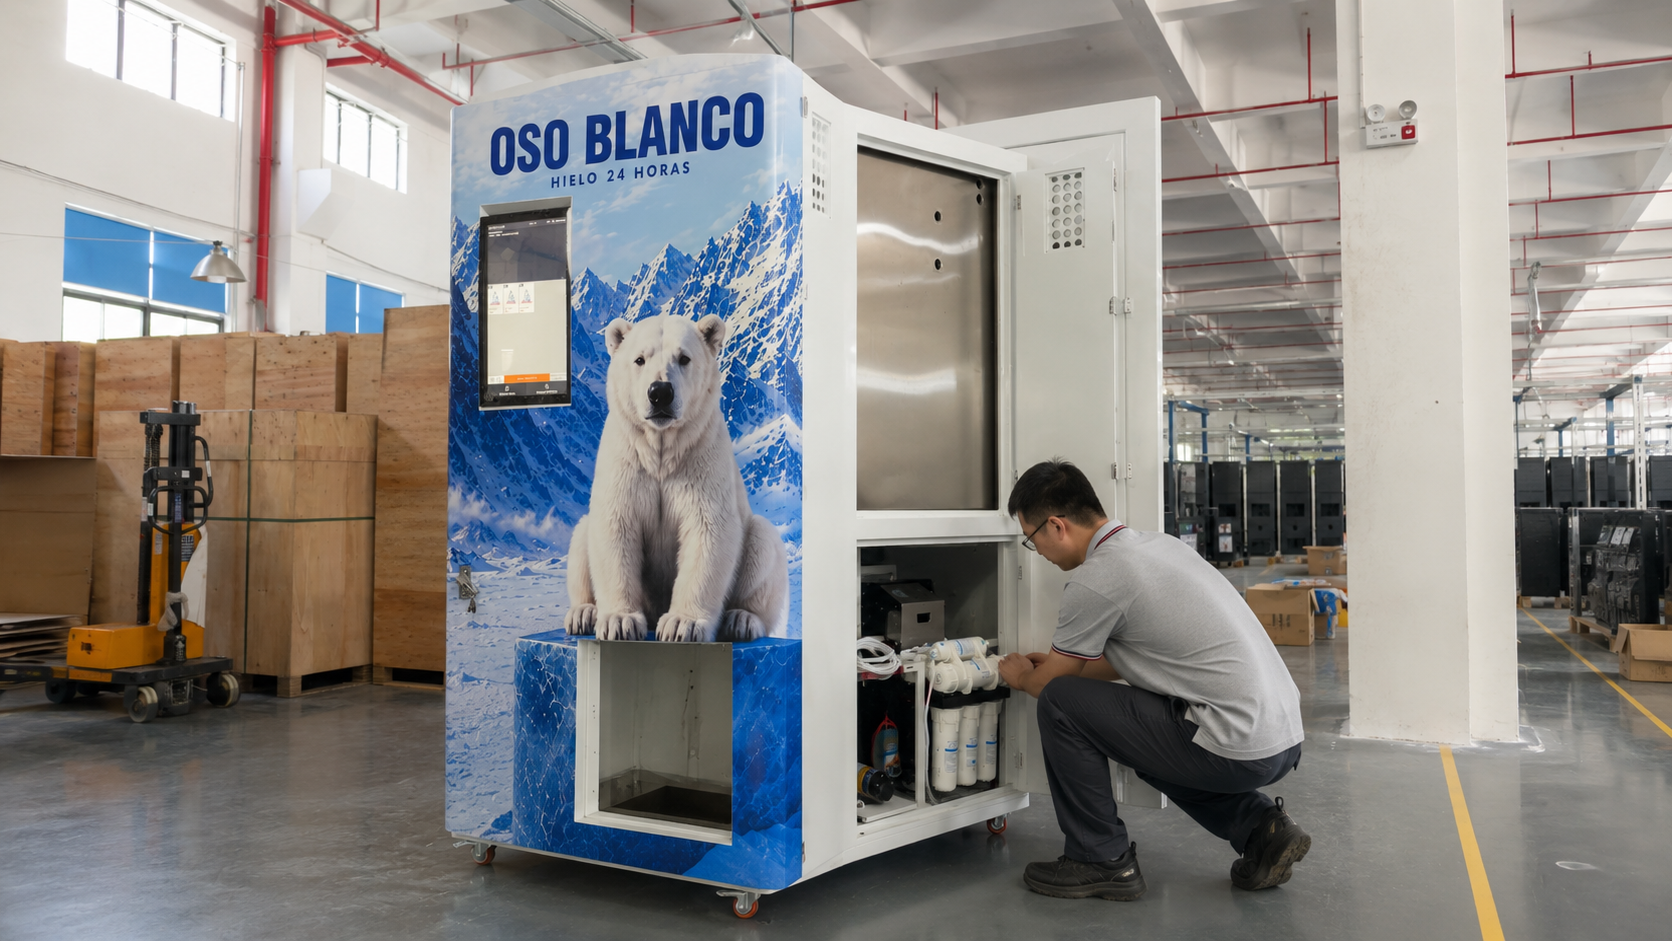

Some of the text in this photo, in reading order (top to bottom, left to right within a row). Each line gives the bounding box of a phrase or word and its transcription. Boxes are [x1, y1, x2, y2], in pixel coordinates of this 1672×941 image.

[490, 92, 765, 176] OSO BLANCO
[551, 161, 690, 189] HIELO 24 HORAS
